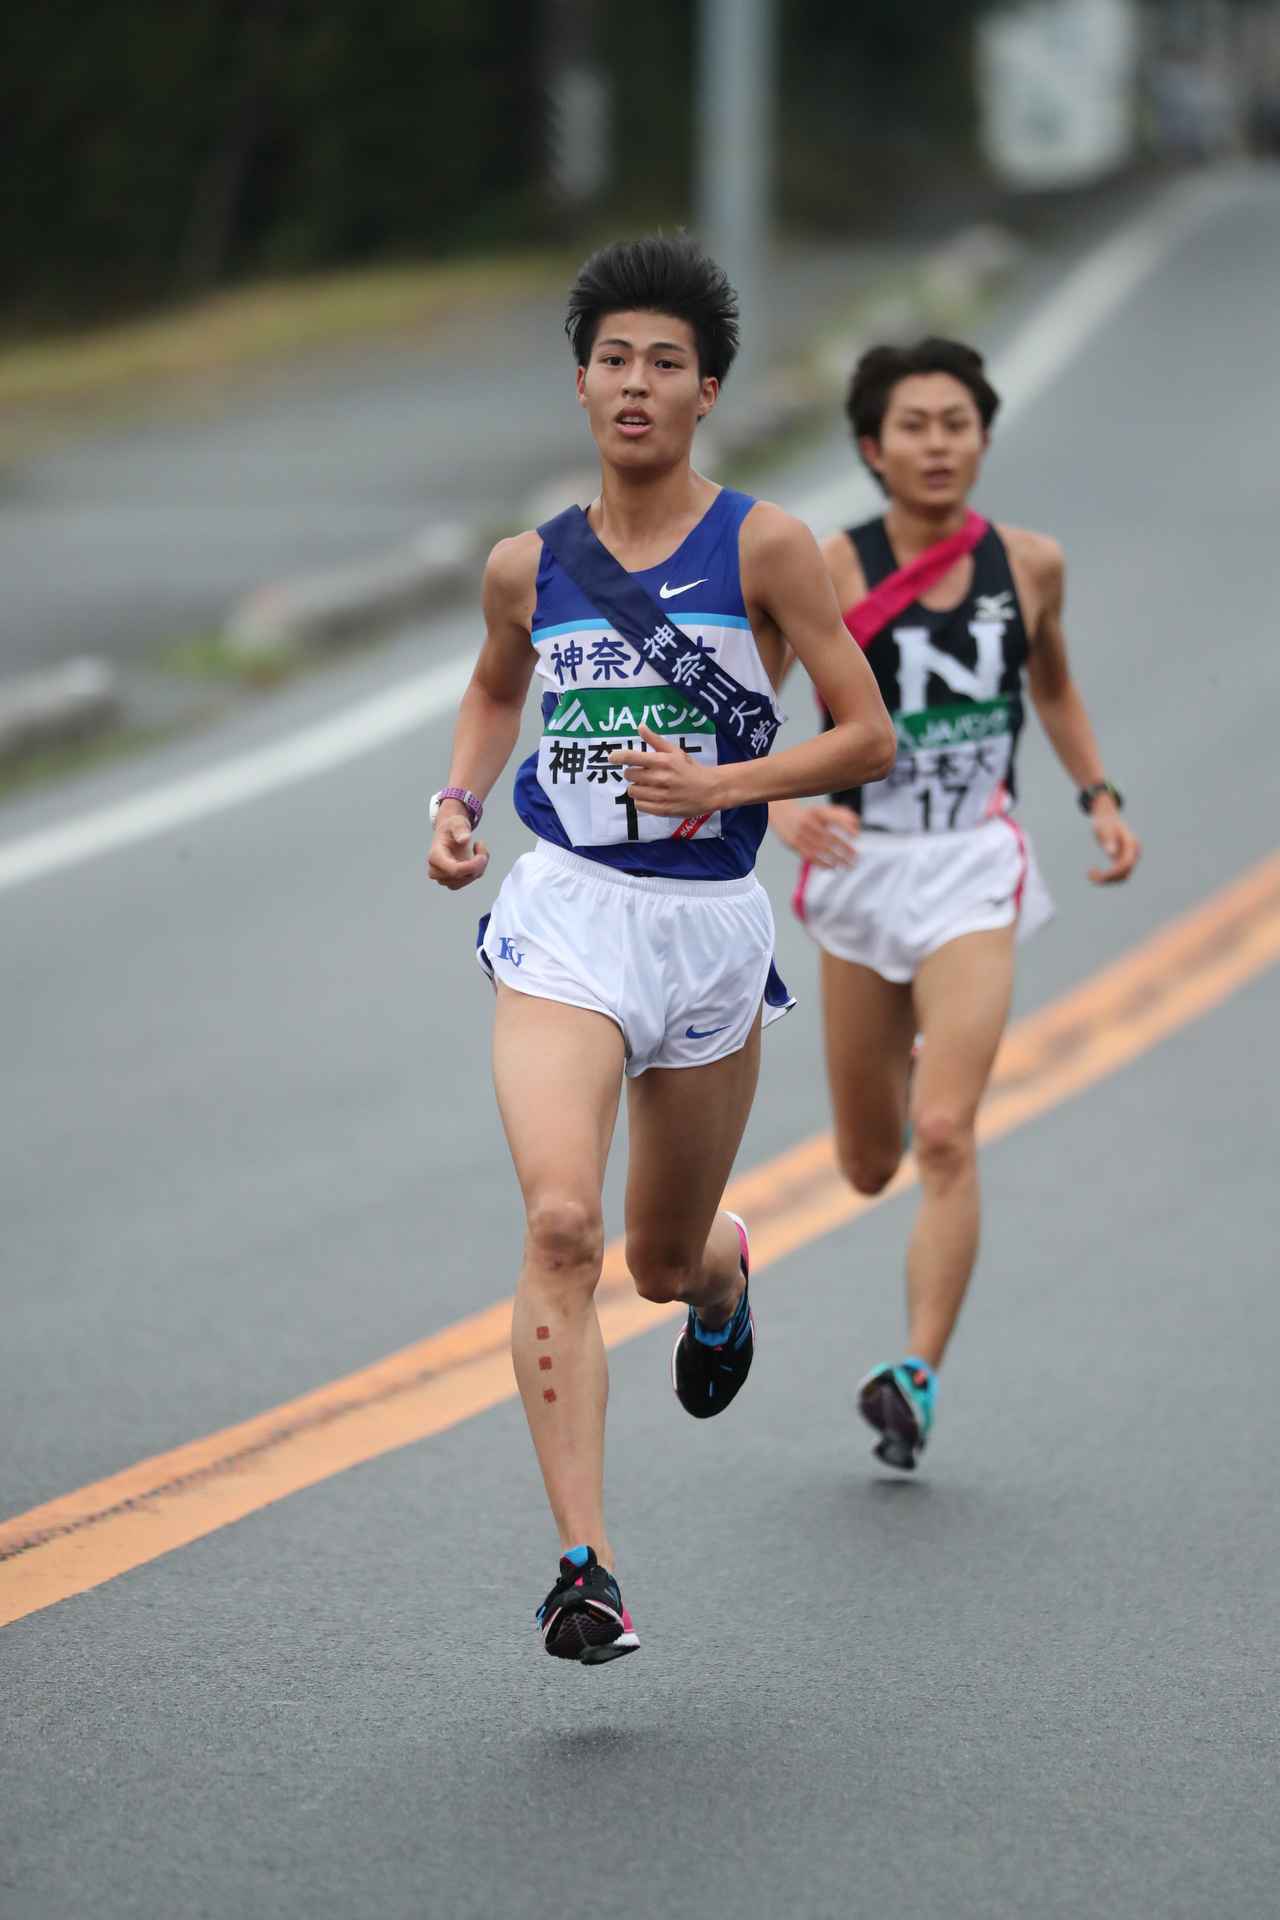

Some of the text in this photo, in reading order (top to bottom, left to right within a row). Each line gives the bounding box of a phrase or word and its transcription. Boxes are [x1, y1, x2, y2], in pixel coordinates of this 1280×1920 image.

[642, 624, 778, 755] 神奈川大学
[891, 620, 1007, 713] N
[917, 784, 968, 832] 17
